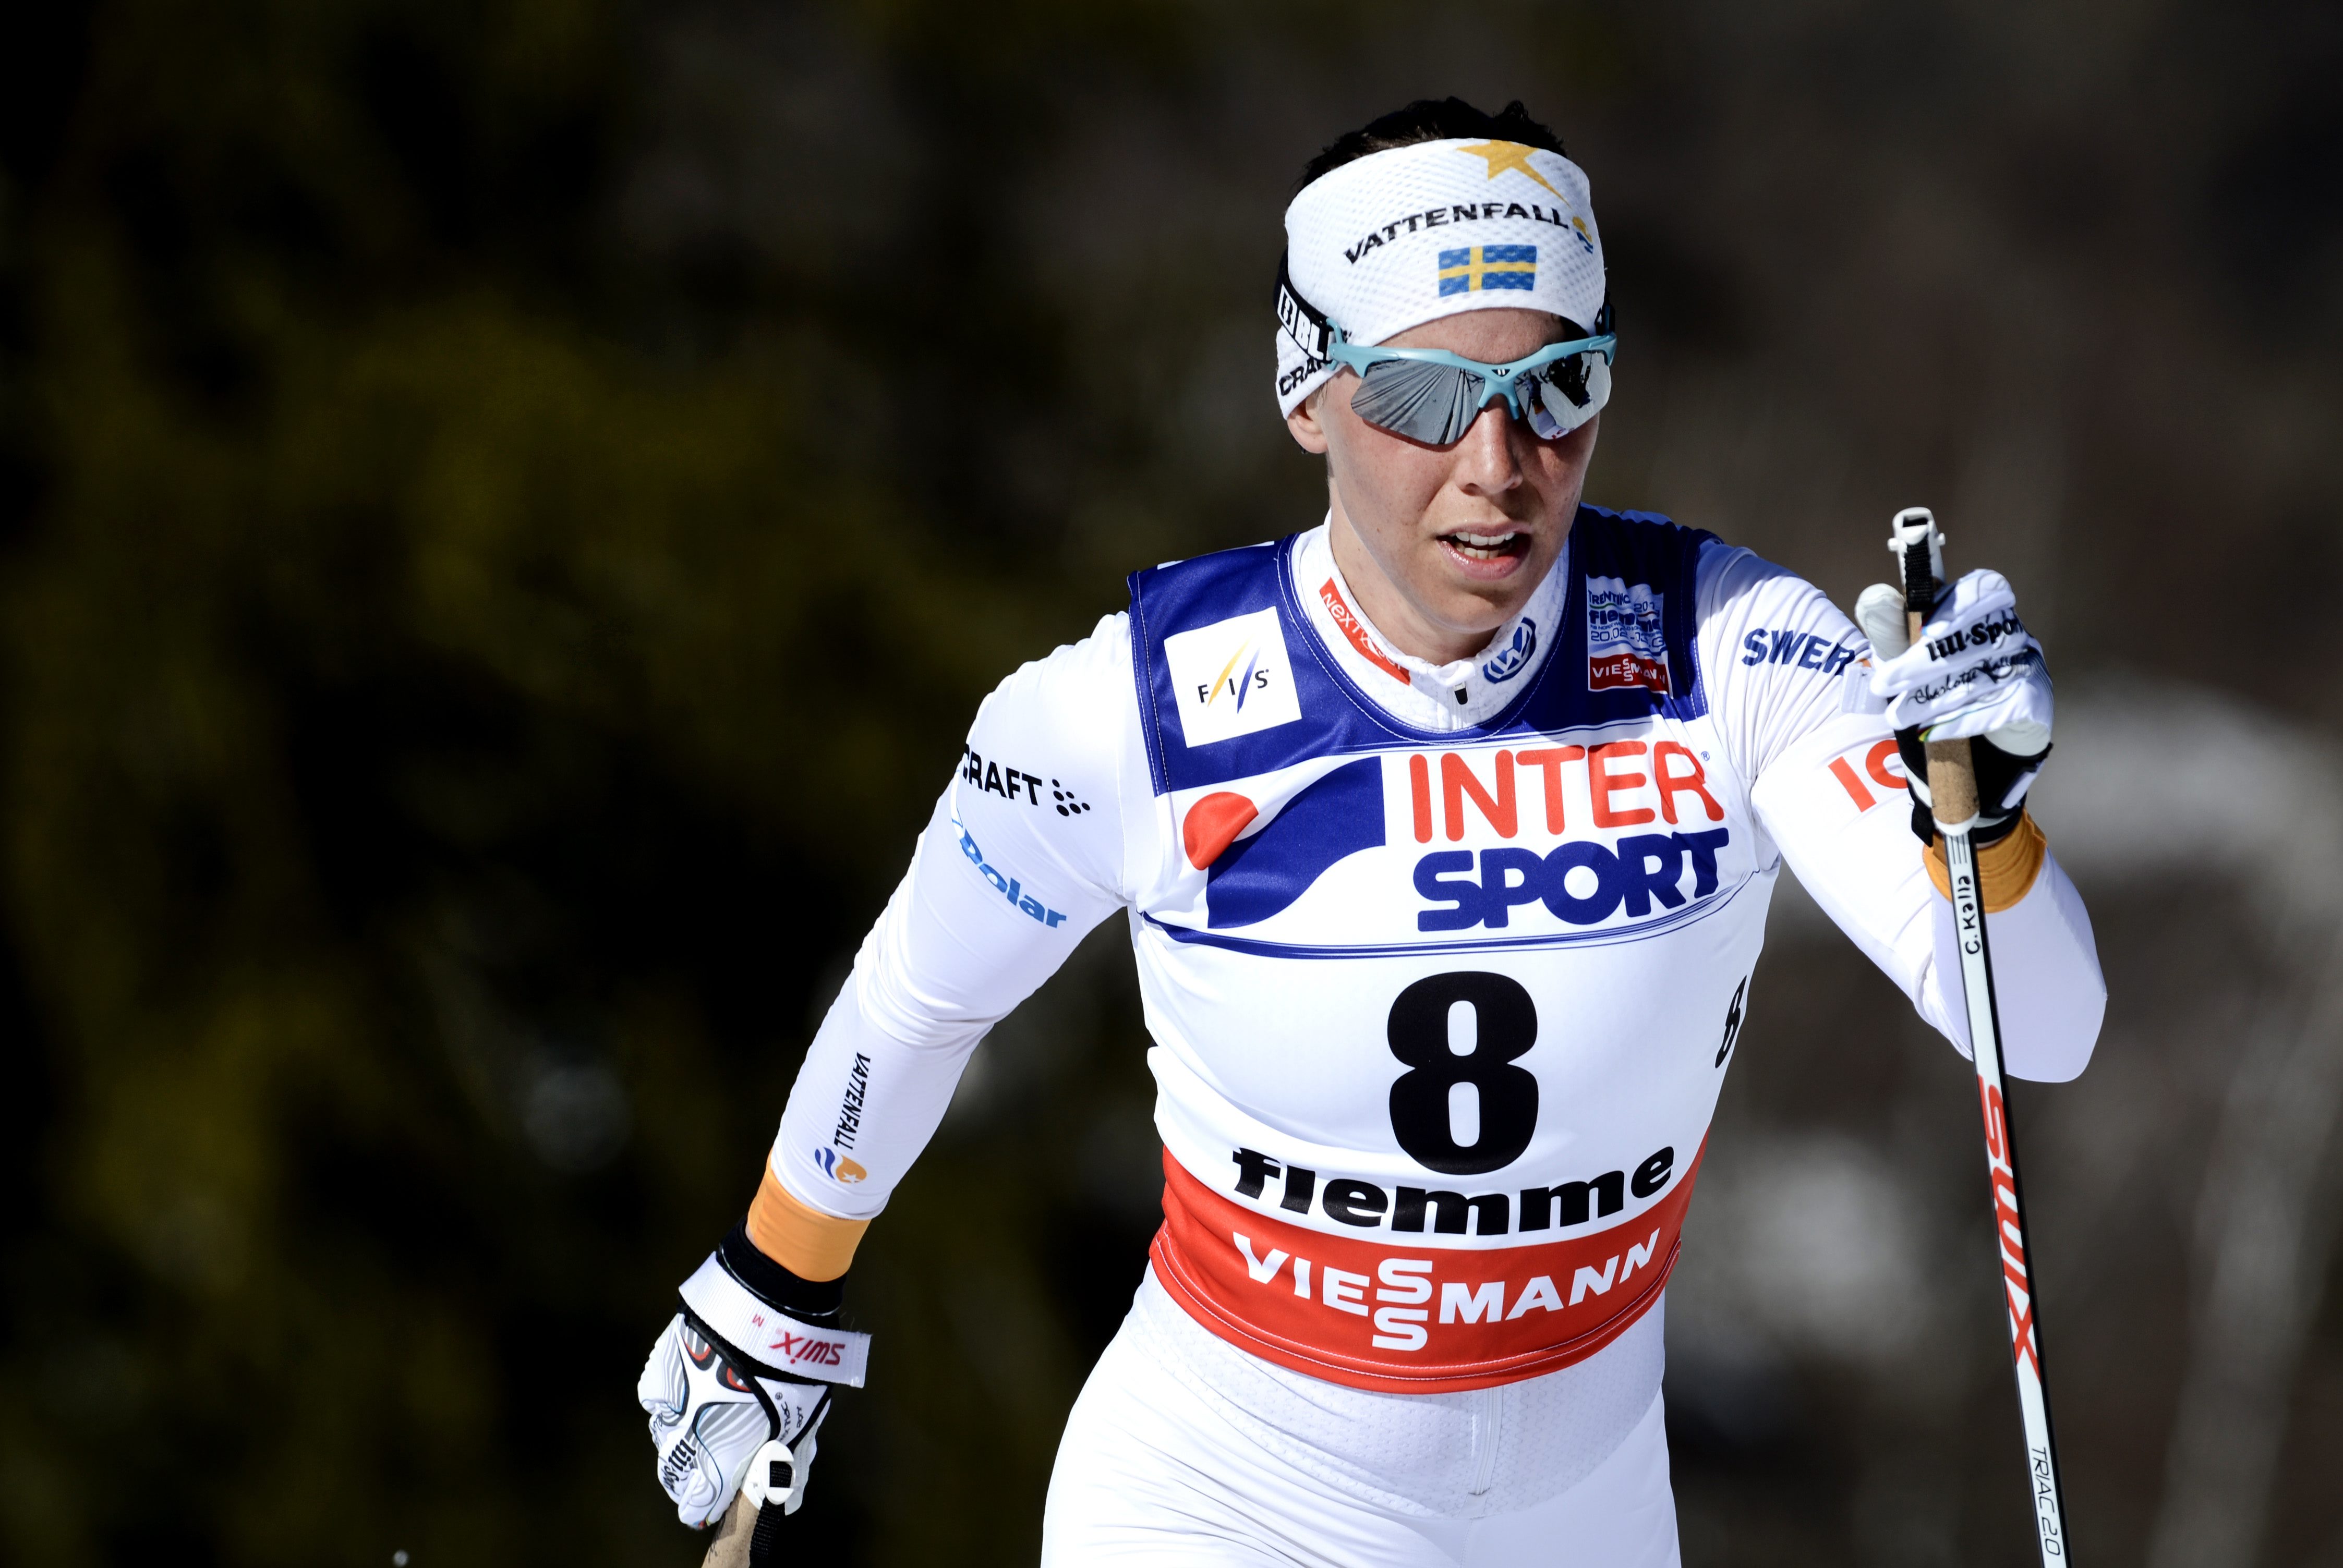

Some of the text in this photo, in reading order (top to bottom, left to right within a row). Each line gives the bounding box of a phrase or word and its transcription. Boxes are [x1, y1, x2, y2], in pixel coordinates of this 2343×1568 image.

[1343, 202, 1569, 264] VATTENFALL
[1198, 671, 1267, 703] FIS
[1409, 740, 1724, 844] INTER
[959, 828, 1067, 929] polar
[1412, 827, 1730, 932] SPORT
[1958, 876, 1976, 930] Kalla
[1714, 975, 1747, 1069] 8
[834, 1051, 871, 1150] VATTENFALL
[1386, 970, 1540, 1175] 8
[1232, 1145, 1675, 1236] fiemme
[1231, 1226, 1661, 1352] VIESSMANN
[2032, 1447, 2061, 1556] TRIAC 2.0
